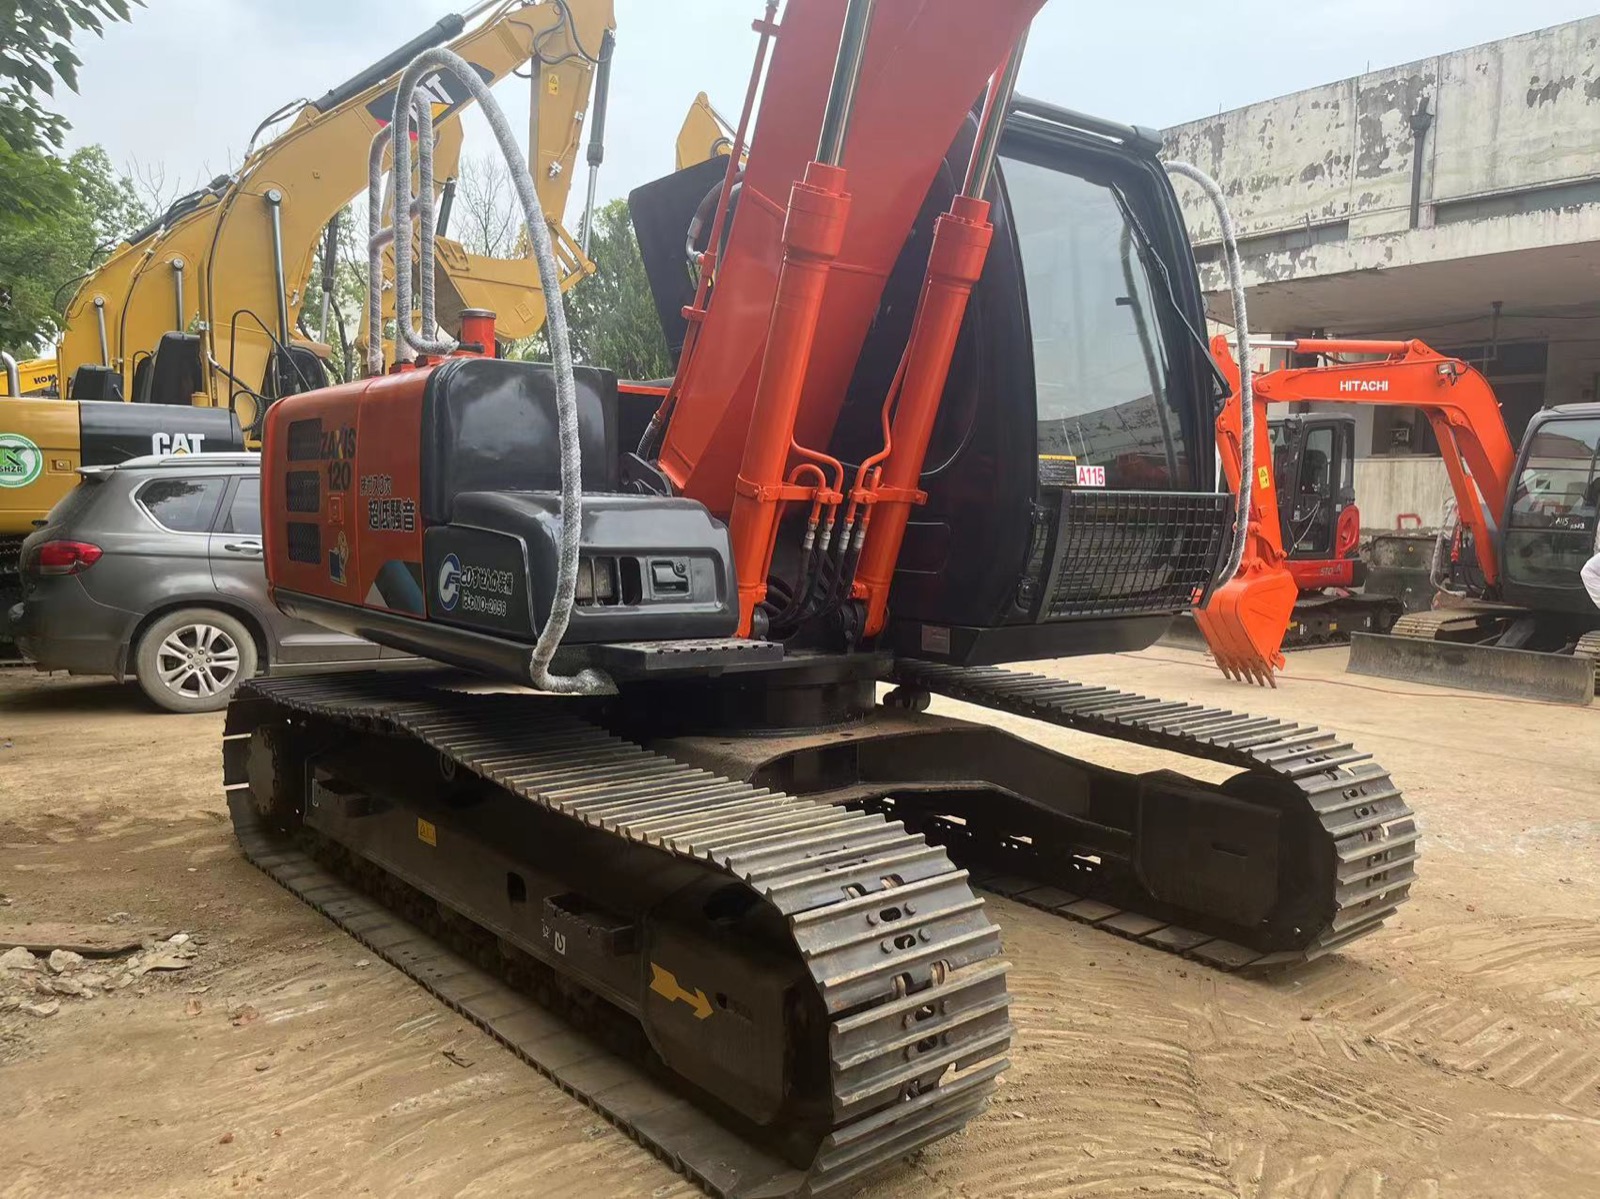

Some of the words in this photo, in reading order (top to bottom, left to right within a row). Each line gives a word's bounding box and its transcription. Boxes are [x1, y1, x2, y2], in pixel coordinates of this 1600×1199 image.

[1340, 380, 1389, 392] HITACHI
[152, 432, 205, 456] CAT
[328, 460, 351, 490] 120
[1078, 466, 1105, 485] A115
